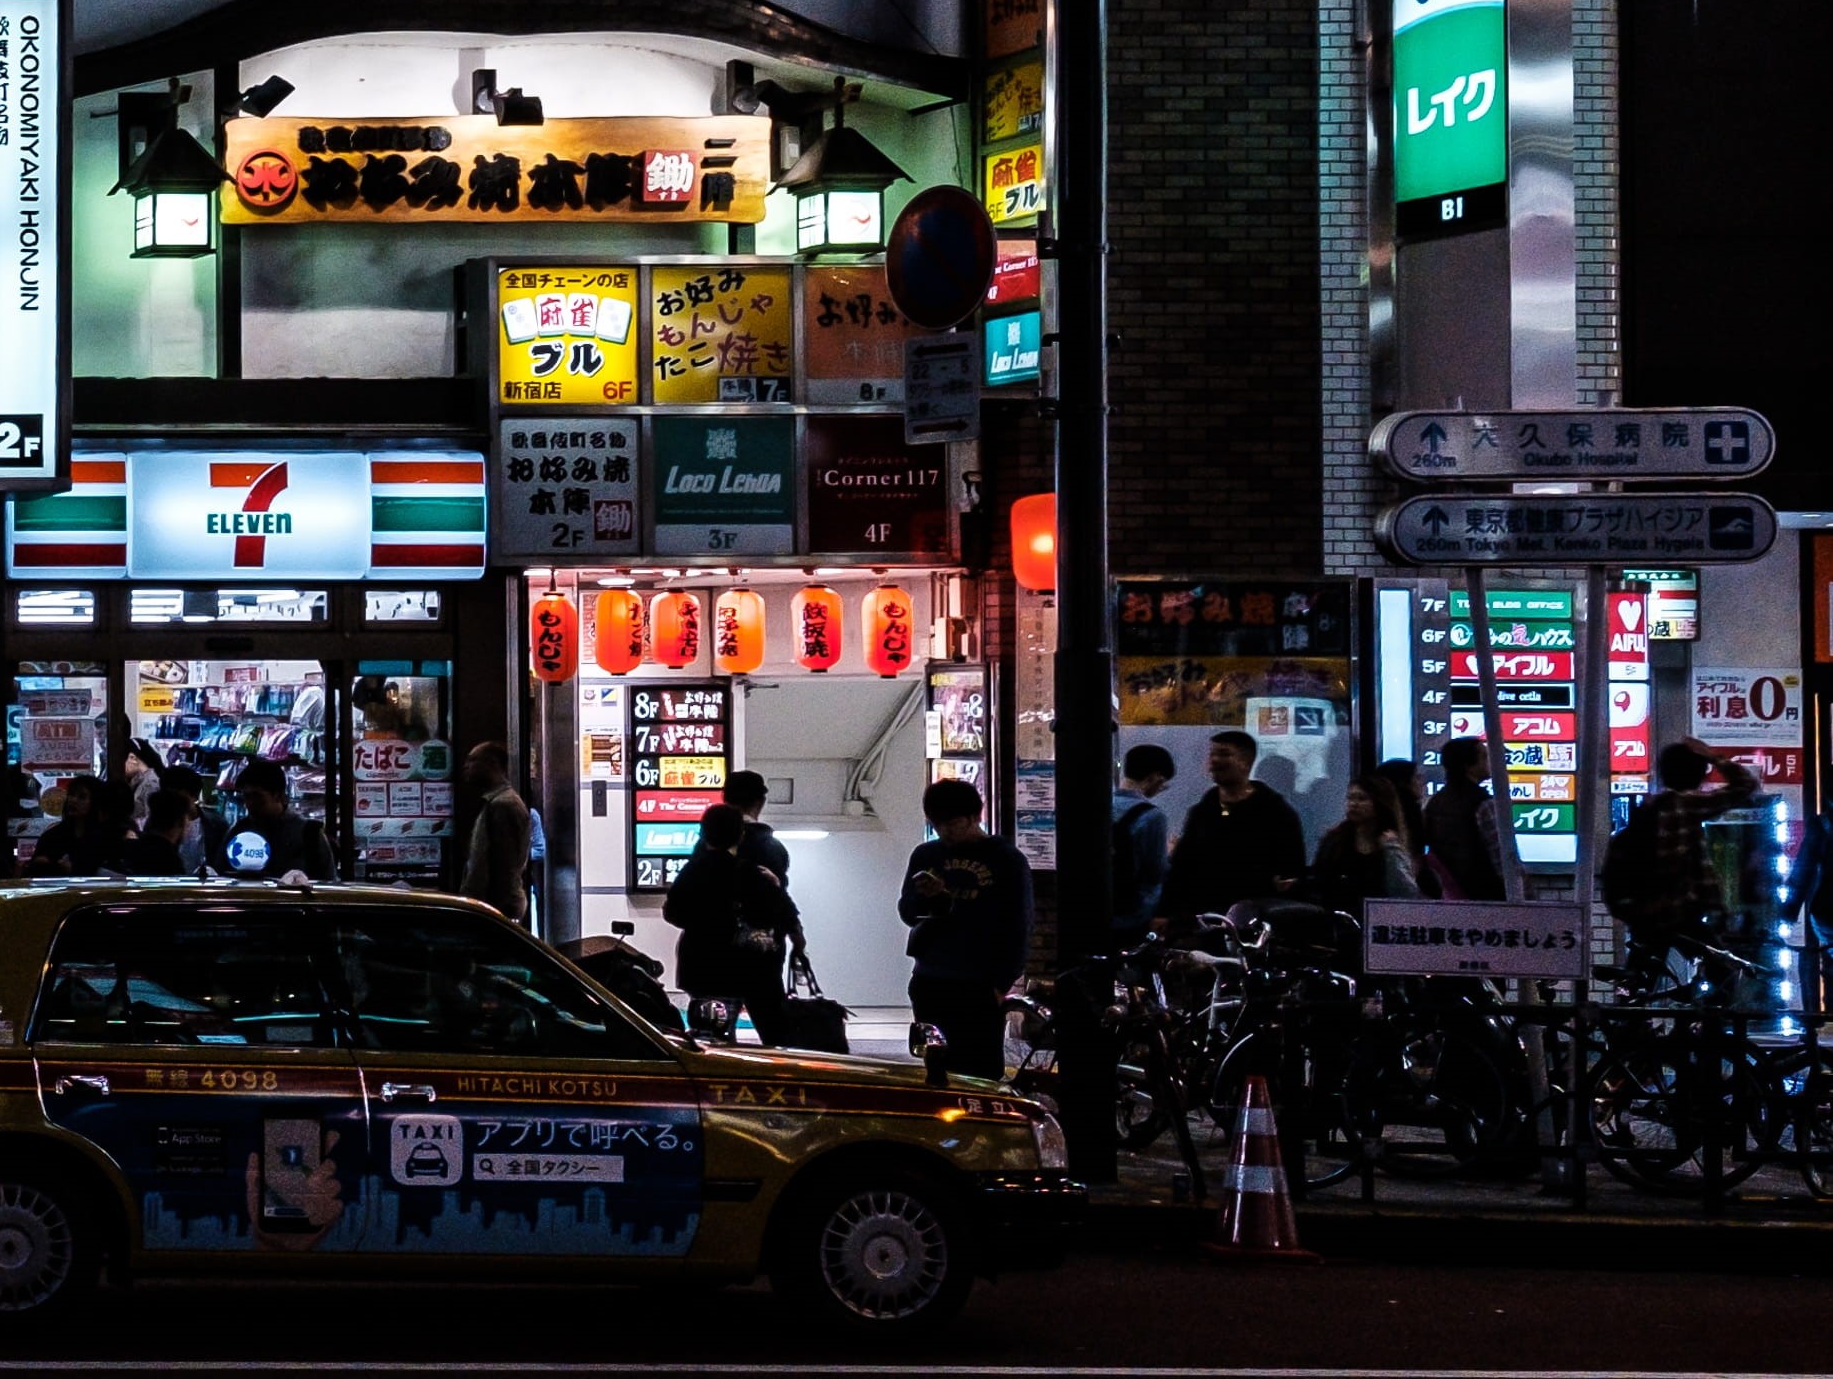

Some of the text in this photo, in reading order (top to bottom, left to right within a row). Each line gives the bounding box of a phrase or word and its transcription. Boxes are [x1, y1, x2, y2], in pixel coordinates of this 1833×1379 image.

[1407, 68, 1497, 136] レイク
[19, 15, 40, 312] OKONOMIYAKI HONJIN
[505, 272, 629, 290] 全国チェーンの店
[530, 343, 604, 378] ブル
[503, 380, 633, 400] 新宿店 6F
[1412, 453, 1457, 468] 260m
[1577, 452, 1639, 467] Hospital
[823, 469, 940, 488] Corner 117
[208, 461, 289, 568] 7
[550, 522, 586, 549] 2F
[863, 523, 893, 544] 4F
[1421, 598, 1447, 612] 7F
[1421, 629, 1447, 643] 6F
[1421, 660, 1447, 673] 5F
[634, 692, 659, 719] 8F
[1421, 691, 1447, 704] 4F
[1421, 720, 1447, 735] 3F
[1512, 717, 1562, 736] アコム
[634, 725, 660, 752] 7F
[353, 742, 412, 771] たばこ
[634, 760, 660, 786] 6F
[637, 860, 662, 886] 2F
[200, 1069, 278, 1091] 4098
[457, 1077, 617, 1097] HITACHI KOTSU
[709, 1085, 807, 1105] TAXI
[399, 1125, 455, 1141] TAXI
[475, 1120, 695, 1152] アプリで呼べる。
[507, 1160, 602, 1176] 全国タクシー
